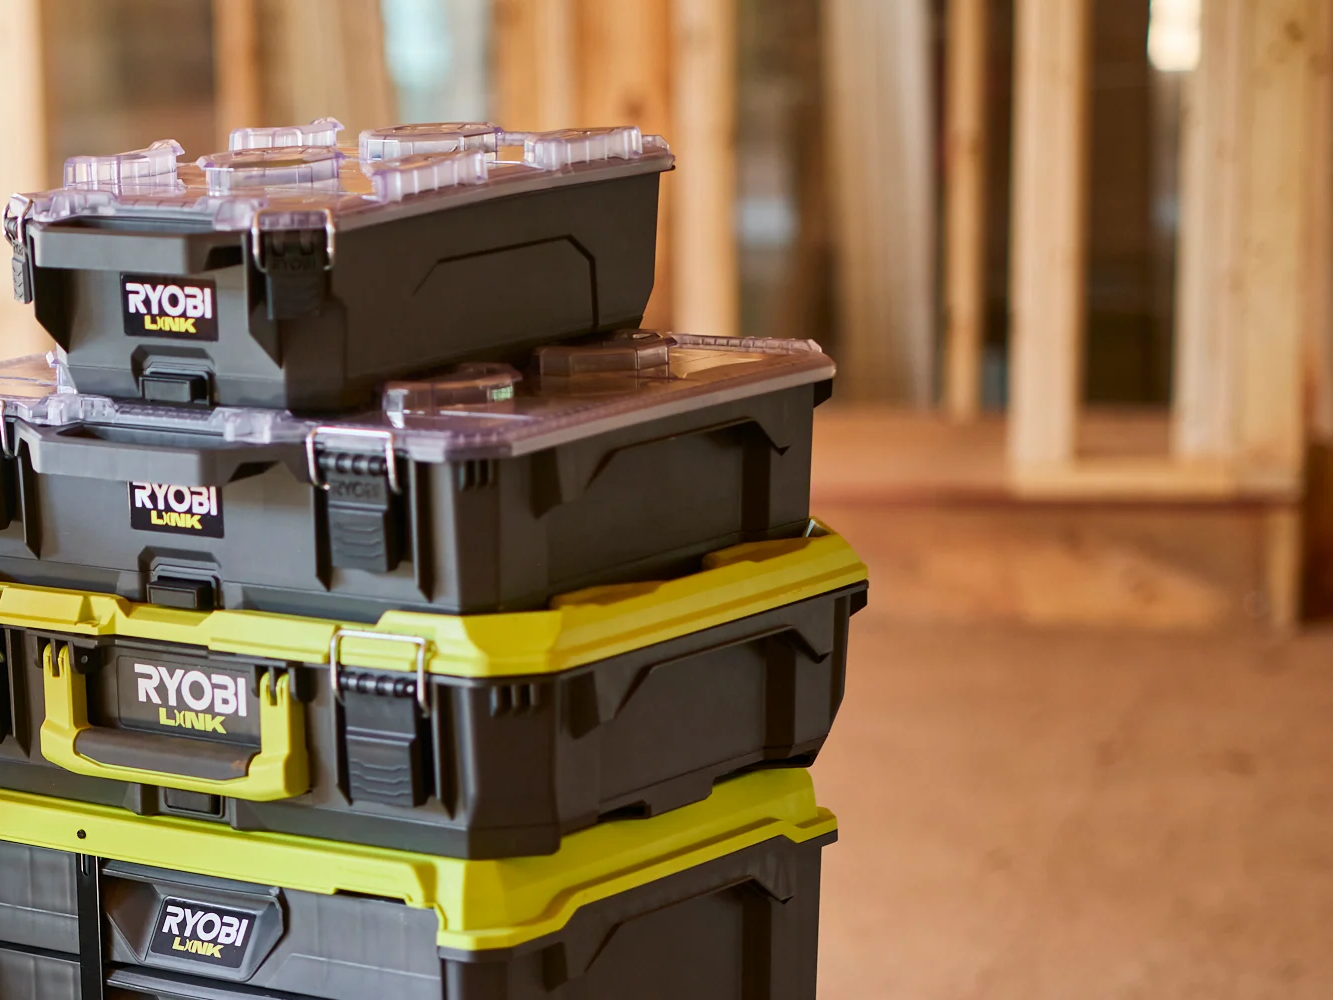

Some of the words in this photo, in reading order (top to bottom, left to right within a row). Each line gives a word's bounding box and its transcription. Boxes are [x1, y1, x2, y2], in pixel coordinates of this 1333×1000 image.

[125, 282, 212, 319] RYOBI
[132, 481, 218, 516] RYOBI
[134, 663, 247, 717] RYOBI
[162, 905, 249, 947] RYOBI
